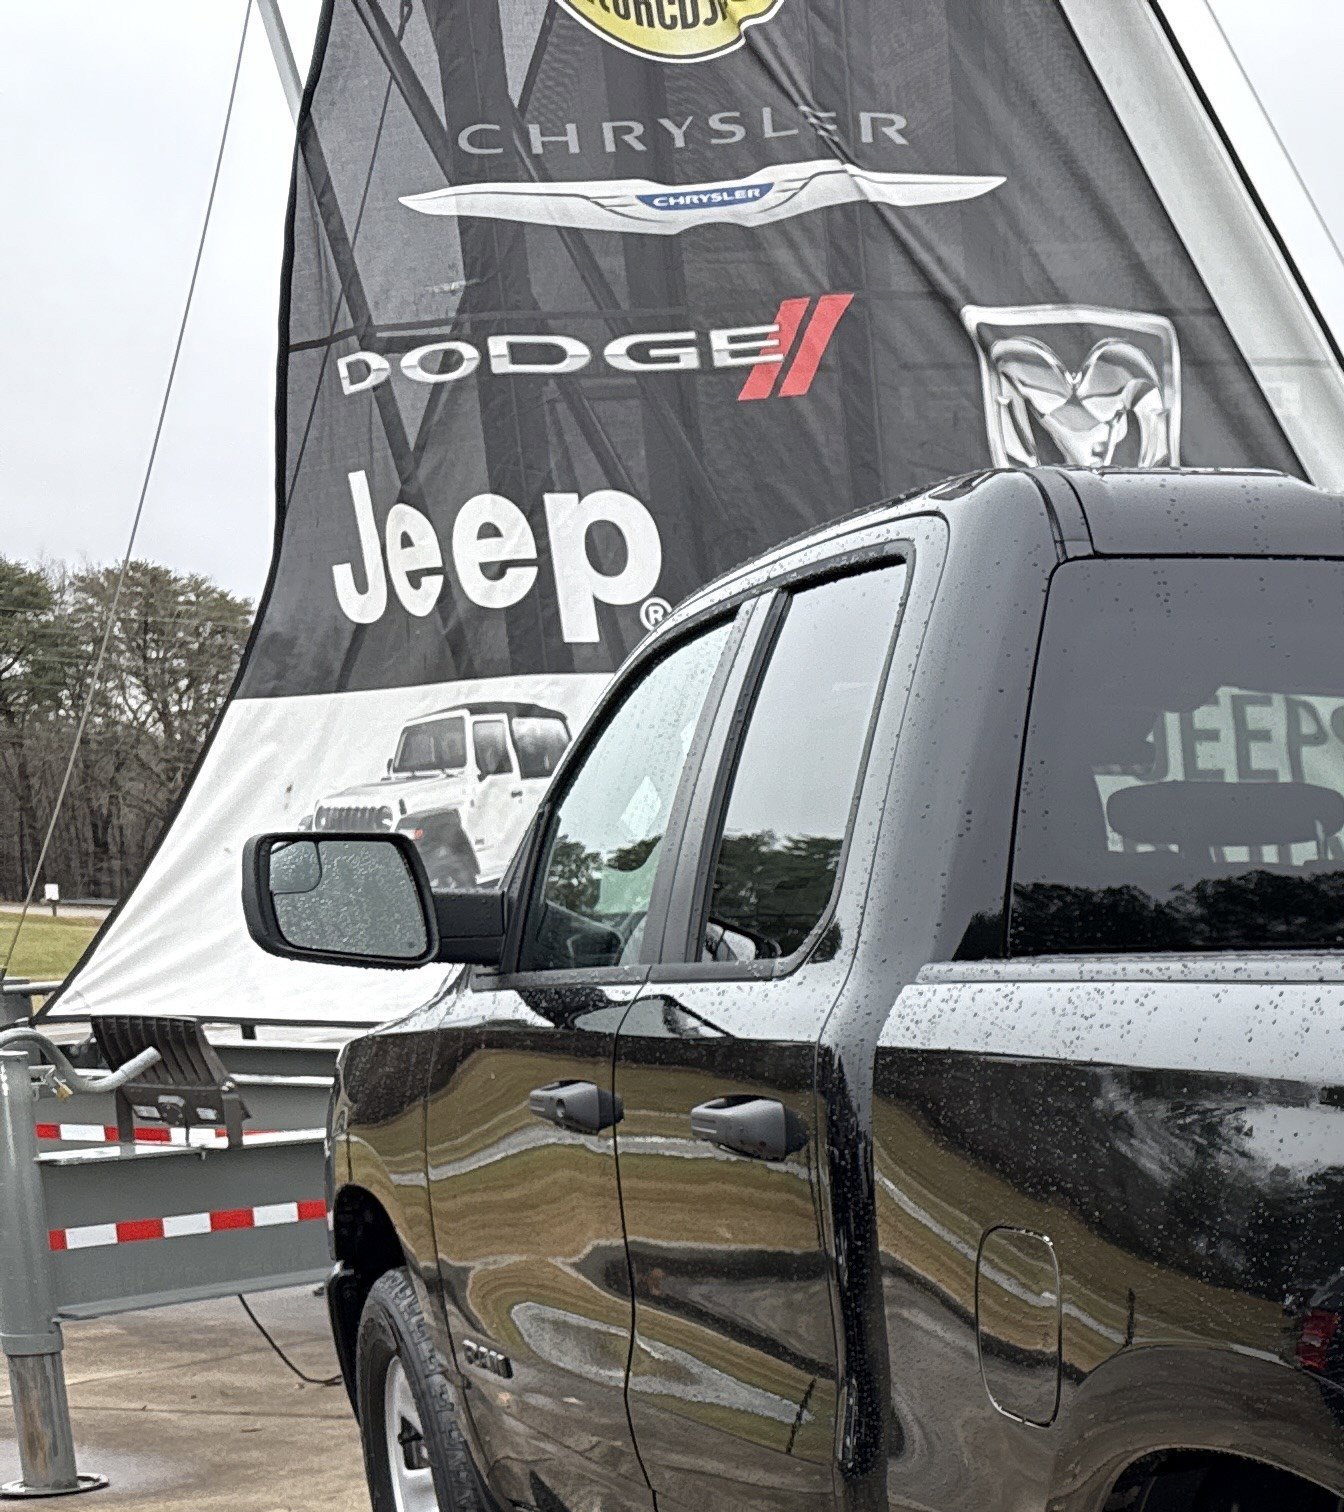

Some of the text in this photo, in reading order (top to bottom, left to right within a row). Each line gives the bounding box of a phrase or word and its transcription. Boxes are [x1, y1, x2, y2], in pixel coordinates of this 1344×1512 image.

[456, 109, 912, 156] CHRYSLER
[652, 188, 762, 207] CHRYSLER
[336, 323, 785, 396] DODGE
[331, 470, 663, 644] Jeep
